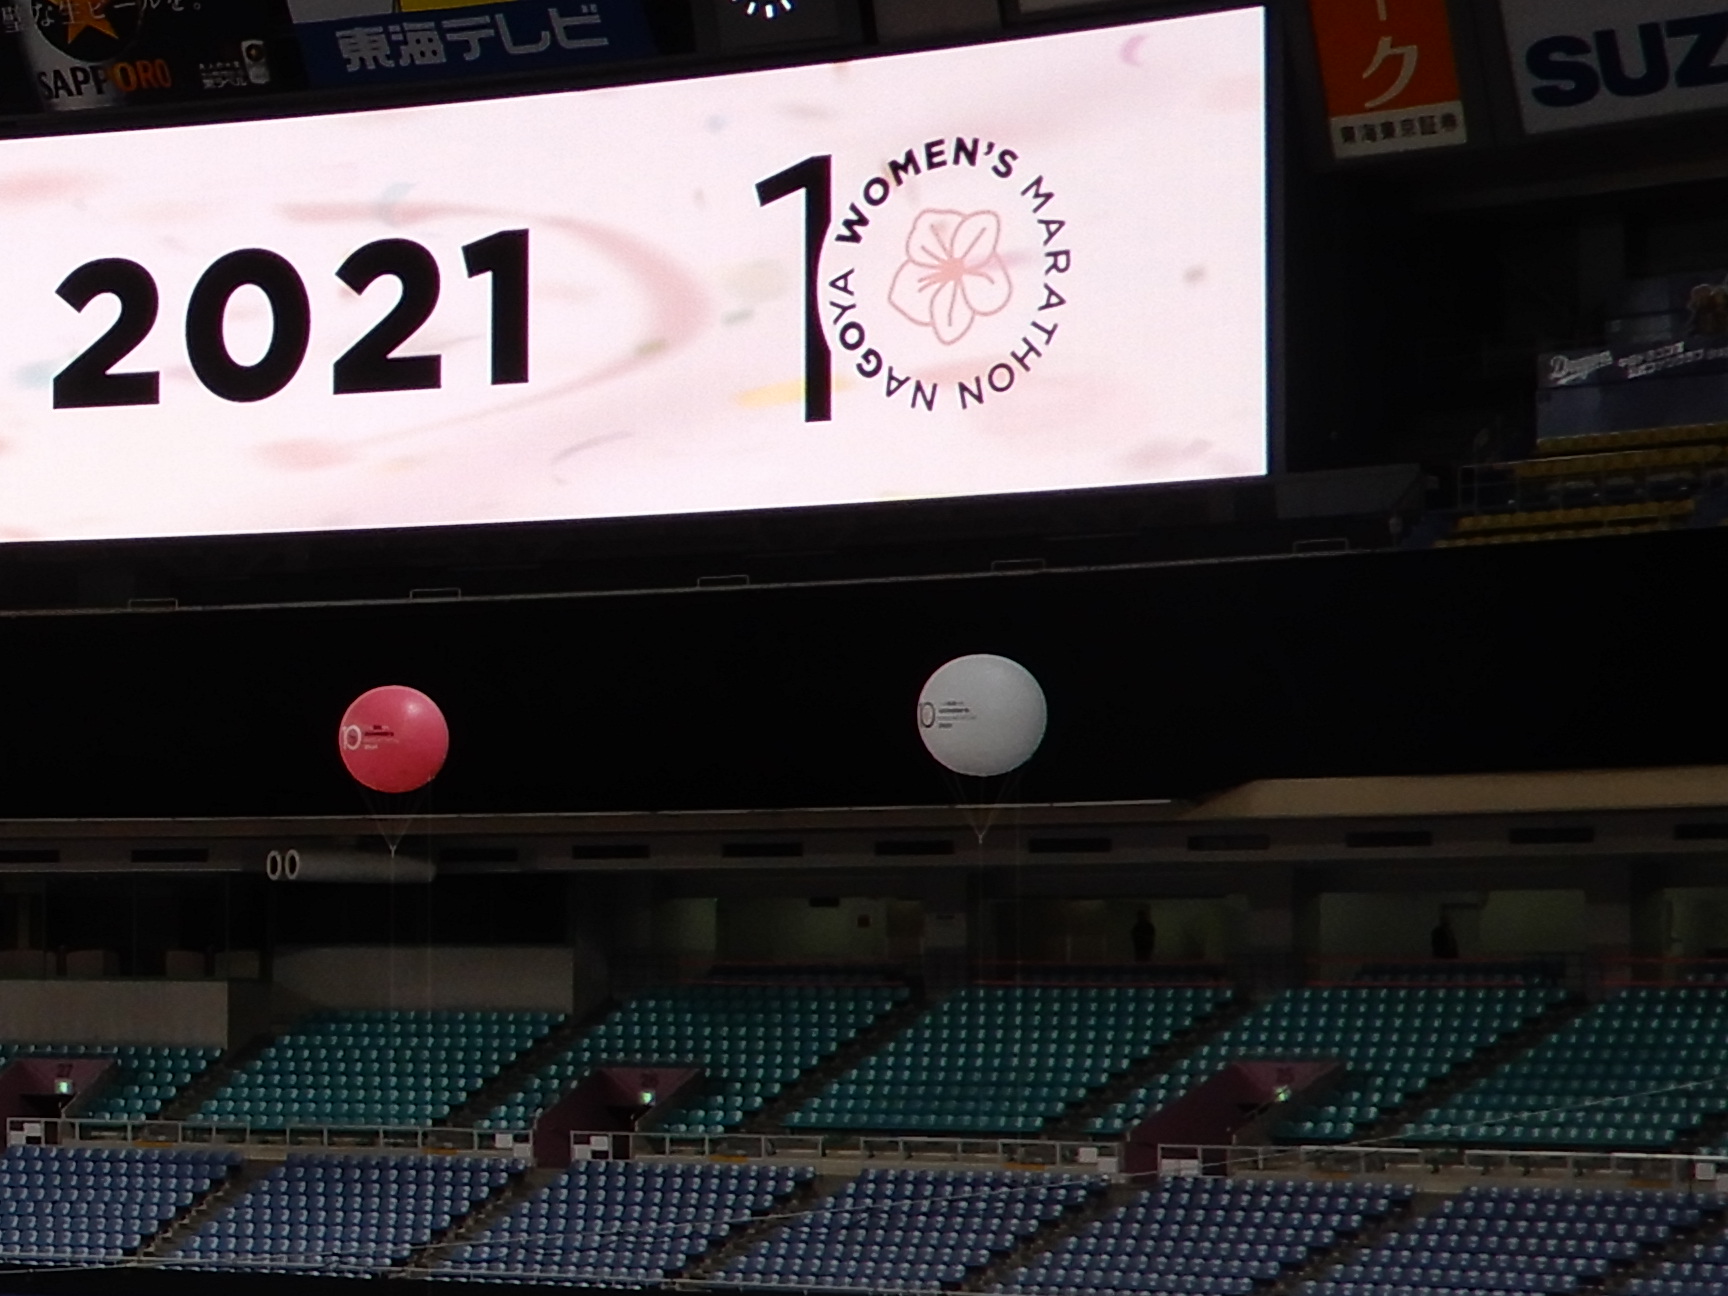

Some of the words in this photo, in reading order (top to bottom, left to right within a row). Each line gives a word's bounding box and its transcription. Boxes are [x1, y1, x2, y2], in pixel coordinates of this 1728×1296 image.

[38, 57, 173, 103] SAPPORO
[336, 5, 610, 73] 東海テレビ
[51, 227, 534, 411] 2021
[829, 268, 938, 411] NAGOYA
[958, 175, 1071, 410] MARATHON
